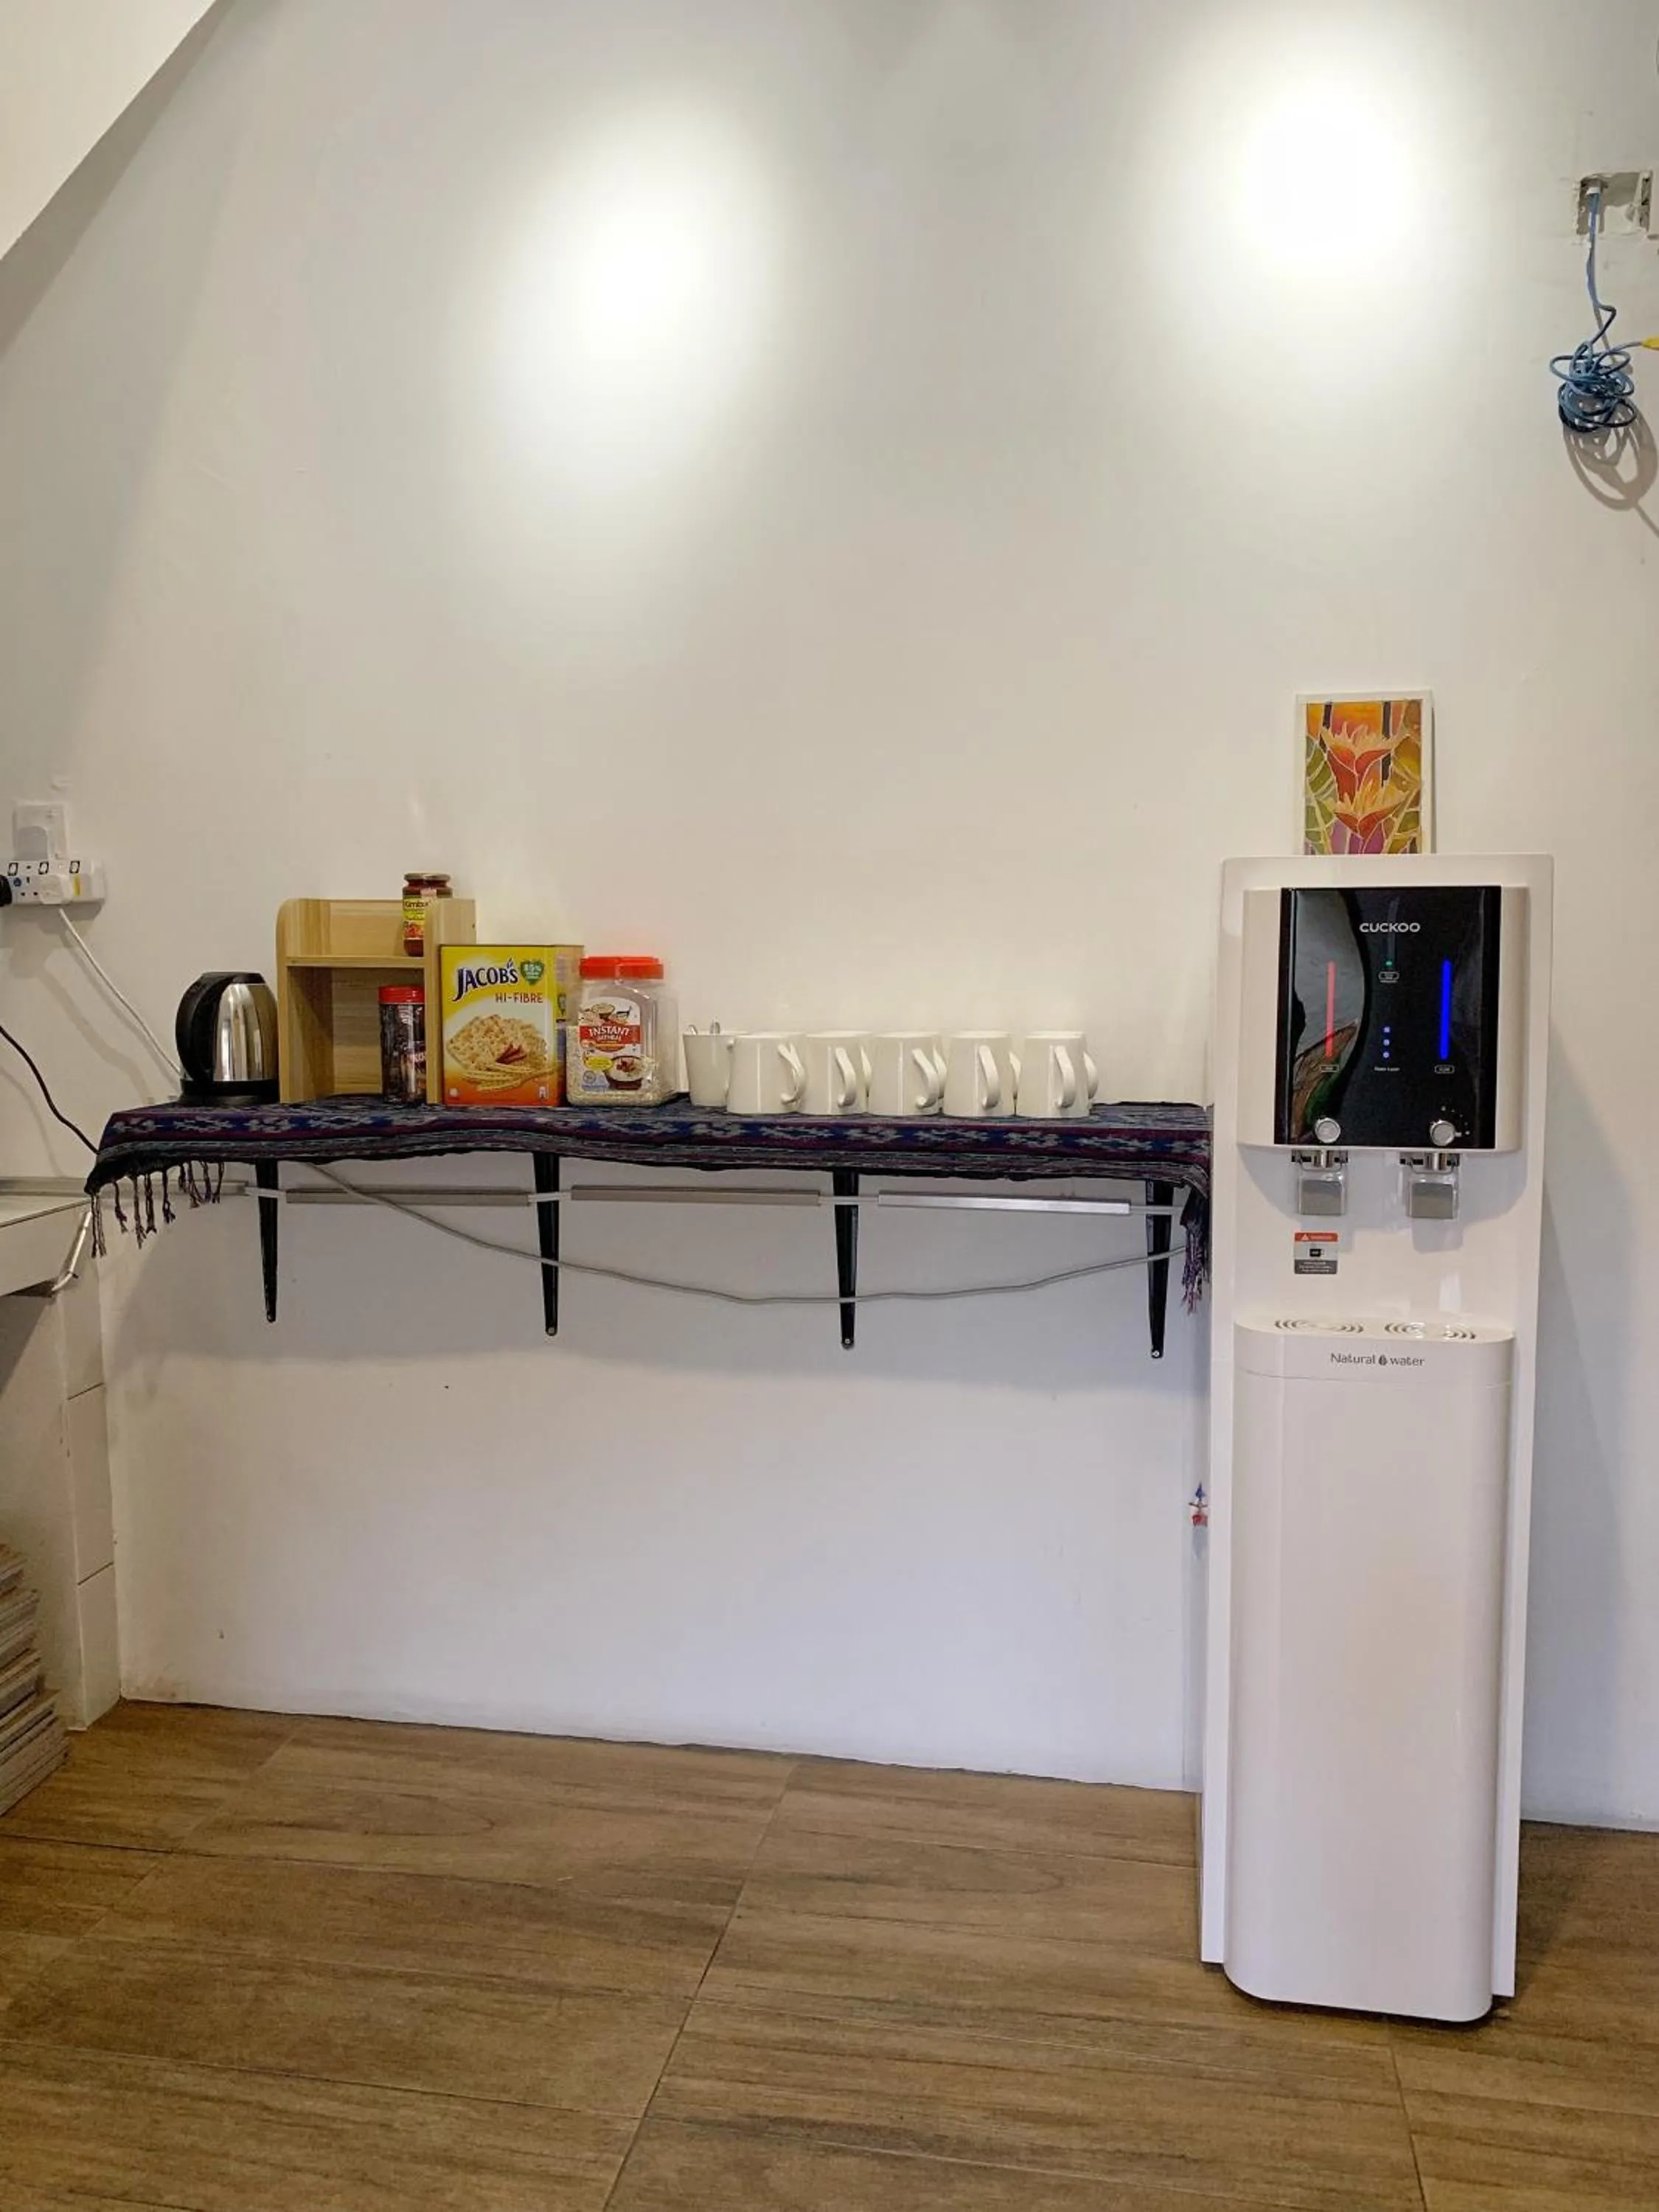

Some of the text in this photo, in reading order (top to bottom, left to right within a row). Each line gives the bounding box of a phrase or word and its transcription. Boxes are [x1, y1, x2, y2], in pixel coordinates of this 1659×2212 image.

[1359, 922, 1420, 933] CUCKOO
[451, 958, 519, 1001] JACOB'S
[495, 992, 543, 1004] HI-FIBRE
[588, 1026, 630, 1037] INSTANT
[1330, 1353, 1425, 1366] Natural water
